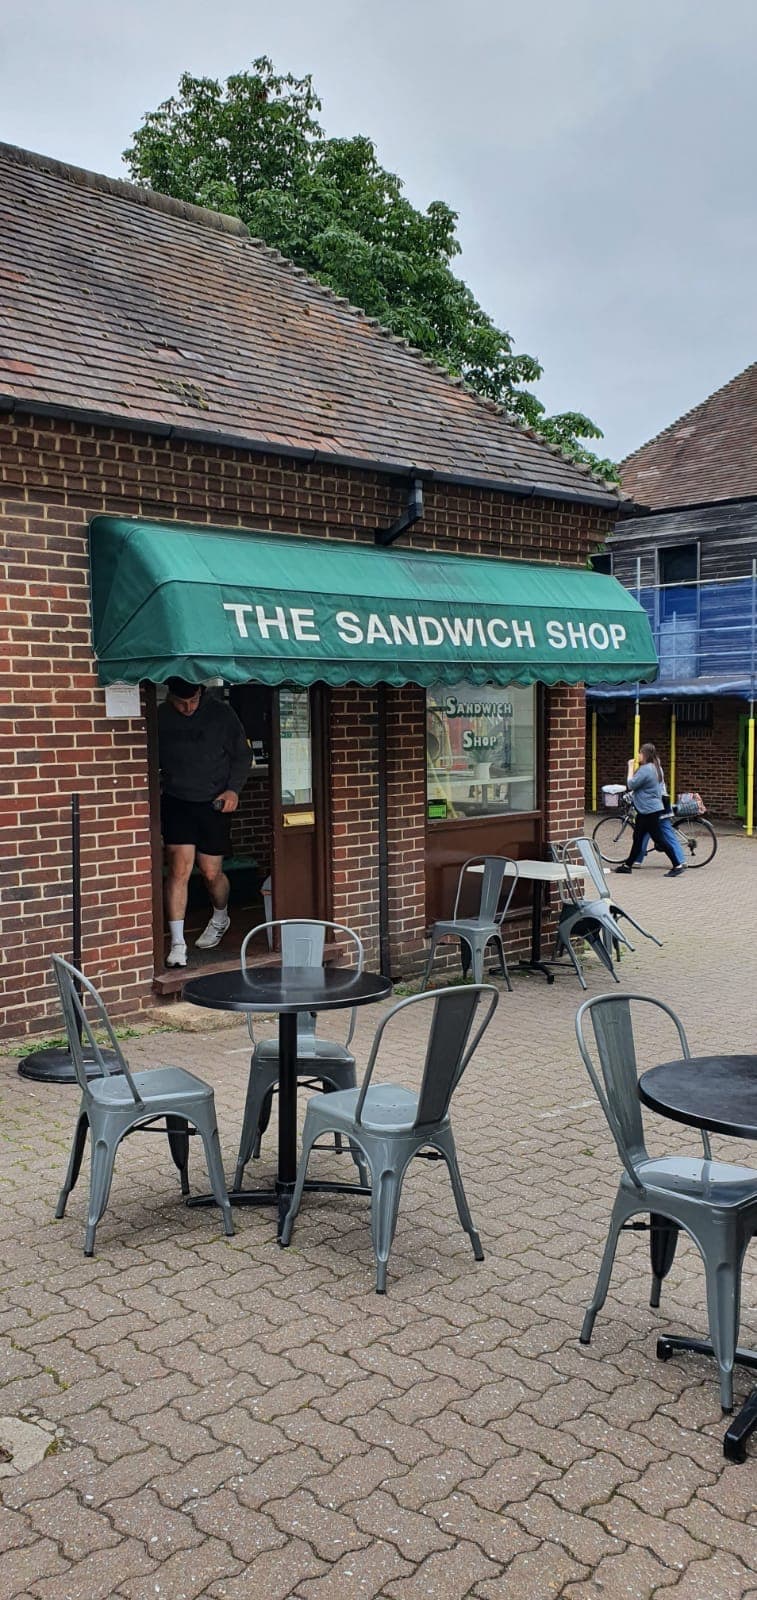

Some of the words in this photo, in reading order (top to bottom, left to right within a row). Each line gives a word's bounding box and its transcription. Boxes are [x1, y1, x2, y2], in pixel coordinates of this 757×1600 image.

[223, 603, 320, 641] THE
[336, 611, 535, 649] SANDWICH
[547, 620, 627, 650] SHOP
[446, 696, 513, 718] SANDWICH
[463, 730, 497, 751] SHOP
